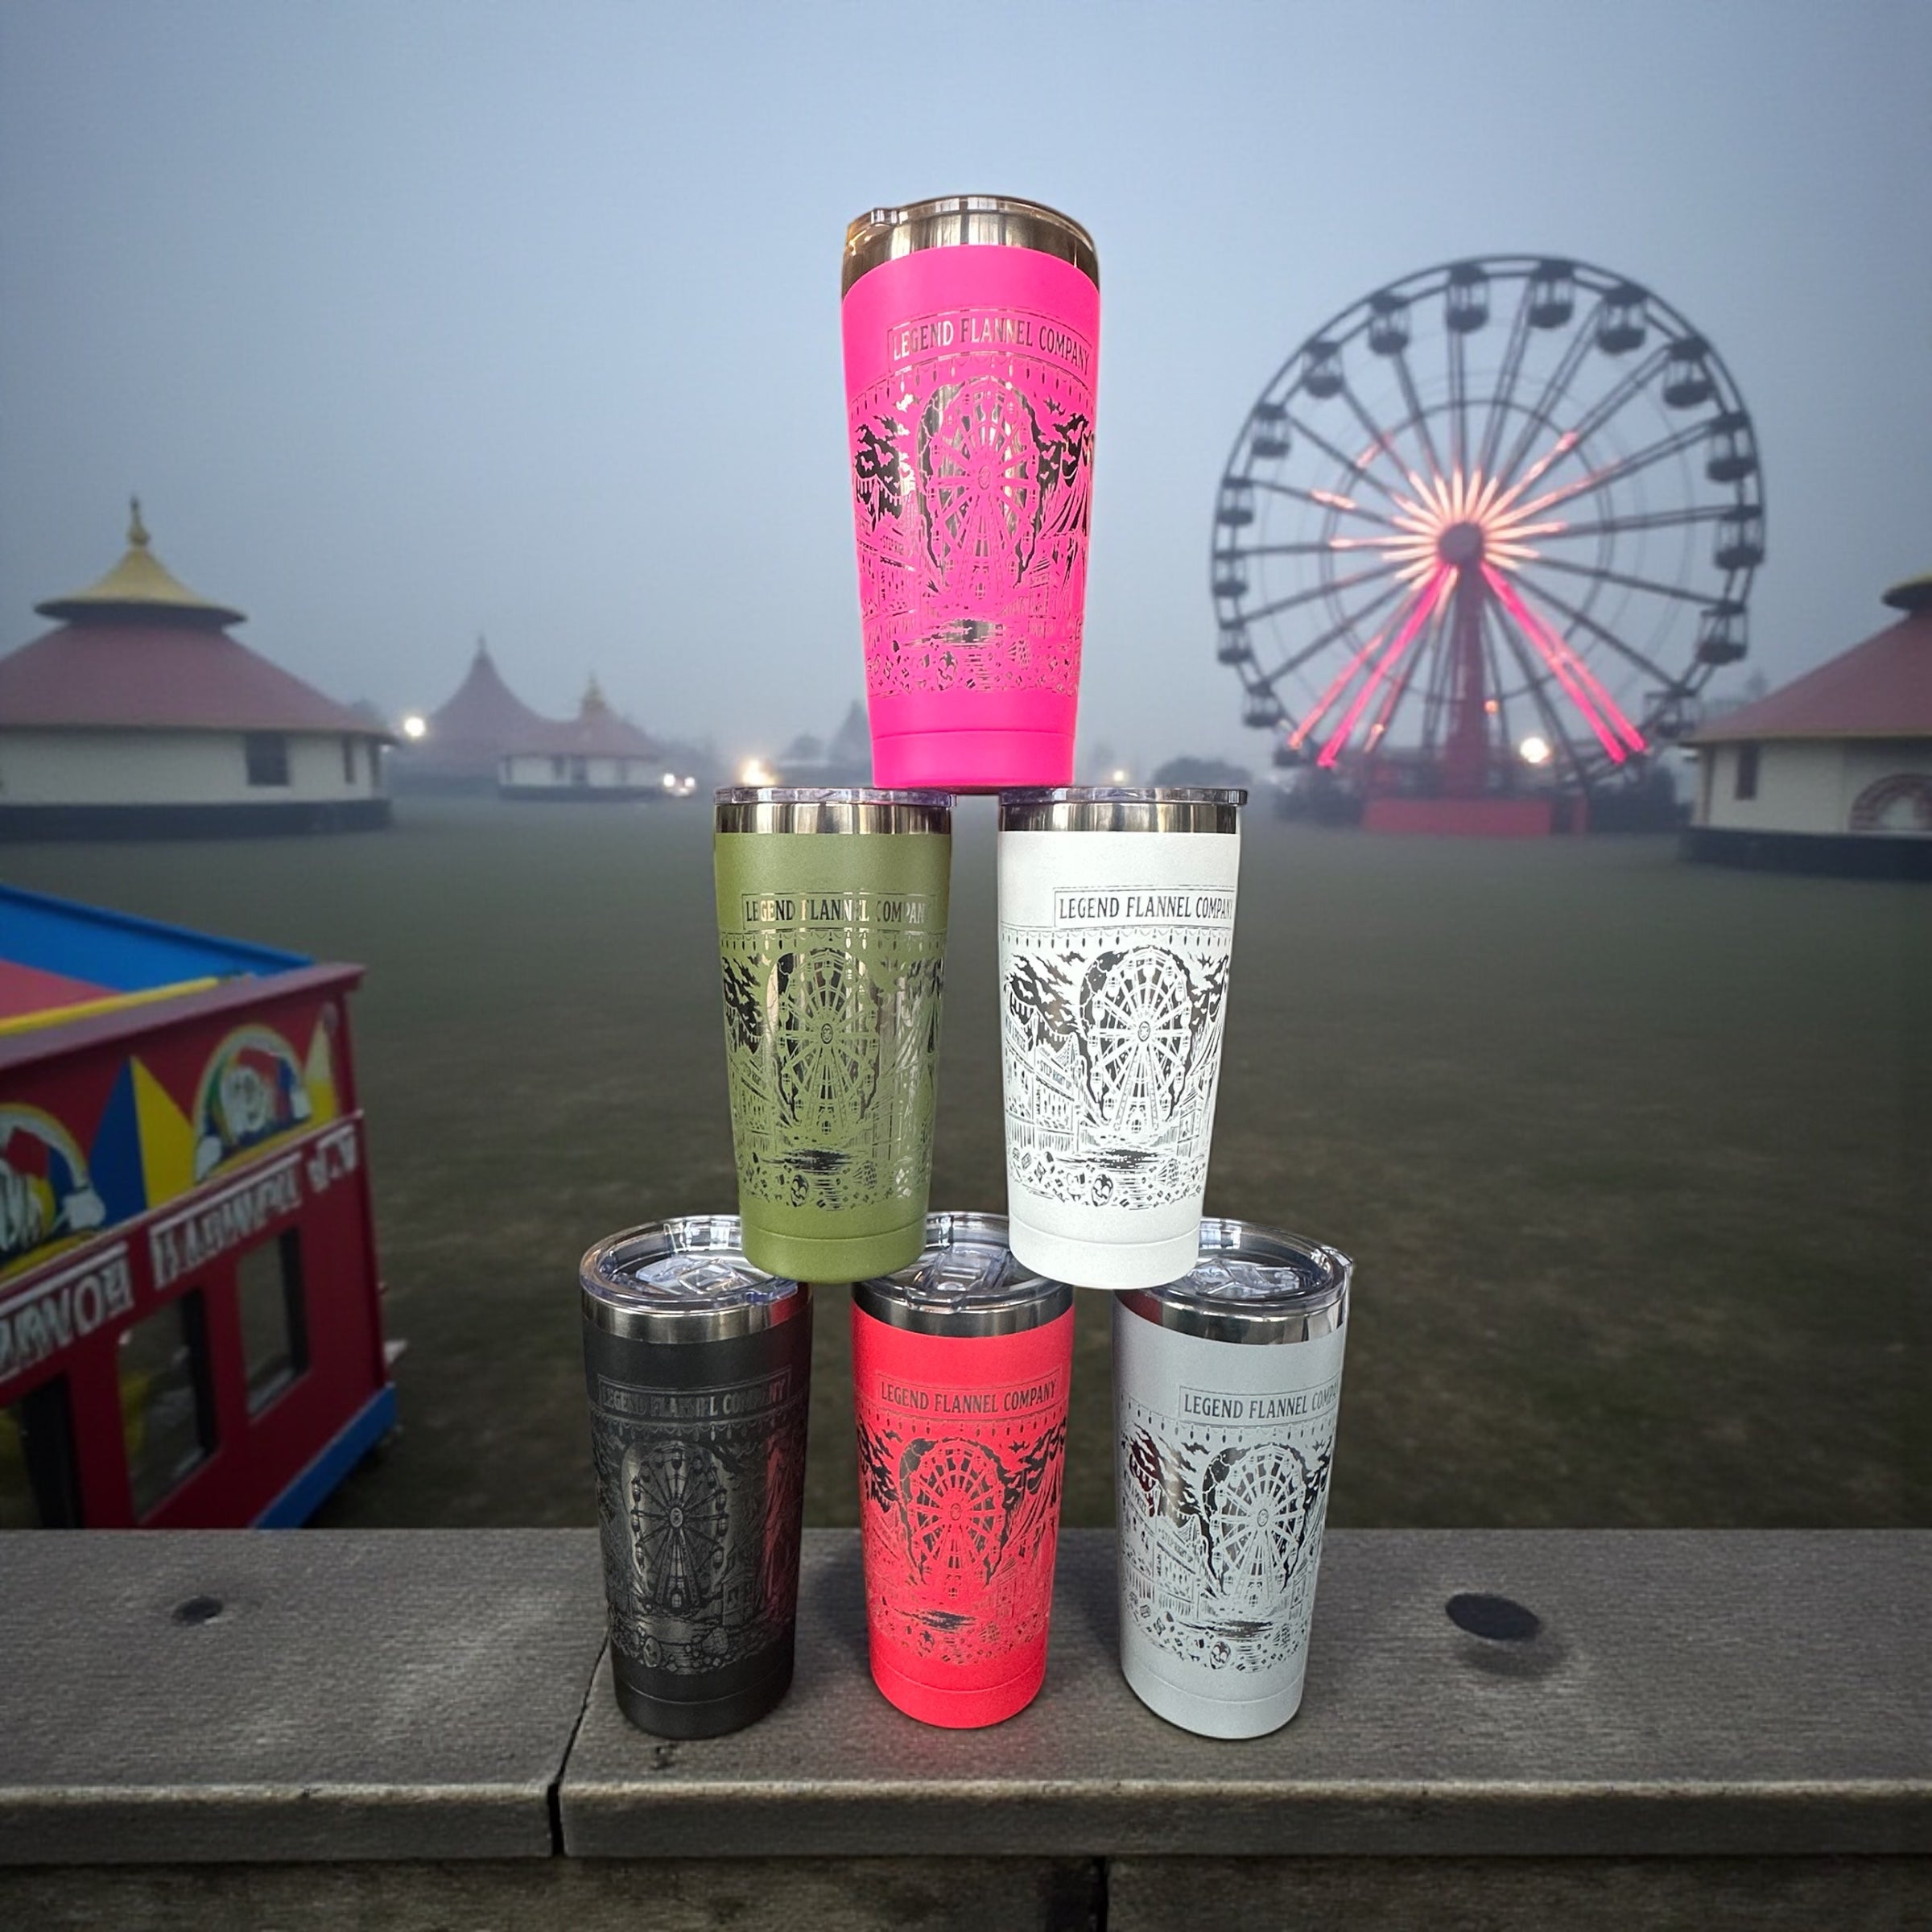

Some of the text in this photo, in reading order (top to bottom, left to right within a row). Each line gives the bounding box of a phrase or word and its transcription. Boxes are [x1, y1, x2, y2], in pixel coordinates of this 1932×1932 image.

[892, 317, 1091, 376] LEGEND FLANNEL COMPANY
[745, 899, 795, 923] LEGEND
[876, 900, 927, 924] COMPAN
[1059, 896, 1233, 919] LEGEND FLANNEL COMPAN
[881, 1379, 1058, 1414] LEGEND FLANNEL COMPANY
[1184, 1393, 1244, 1418] LEGEND
[1249, 1395, 1308, 1419] FLANNEL
